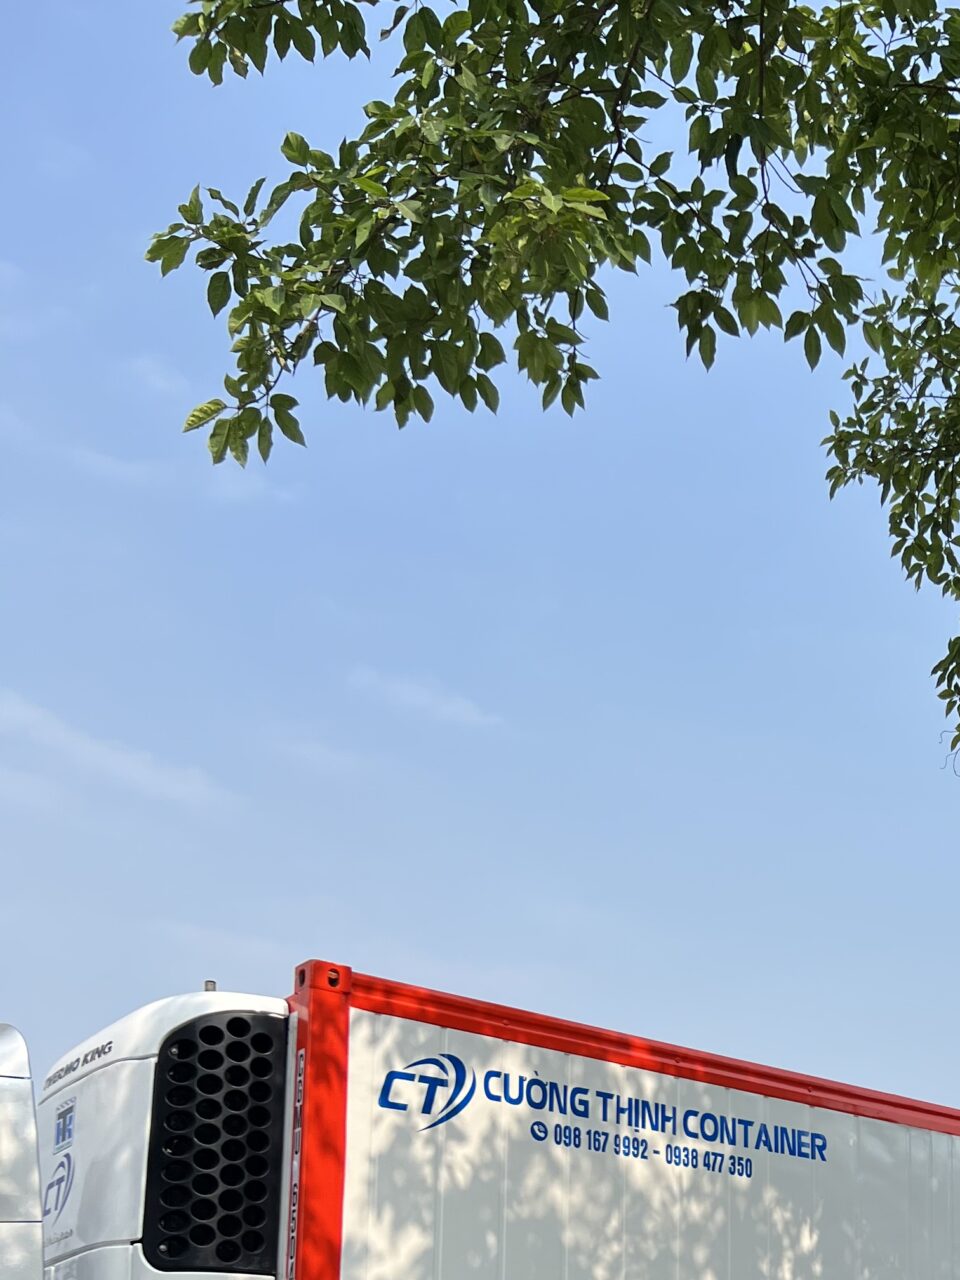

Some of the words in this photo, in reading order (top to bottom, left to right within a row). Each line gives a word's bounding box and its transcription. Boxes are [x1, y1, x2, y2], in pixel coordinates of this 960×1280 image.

[81, 1041, 113, 1067] KING
[484, 1070, 590, 1119] CƯỜNG
[596, 1091, 677, 1136] THỊNH
[683, 1109, 827, 1161] CONTAINER
[554, 1124, 581, 1148] 098
[586, 1130, 609, 1152] 167
[613, 1134, 648, 1160] 9992
[666, 1144, 698, 1168] 0938
[703, 1151, 725, 1173] 477
[729, 1155, 752, 1178] 350
